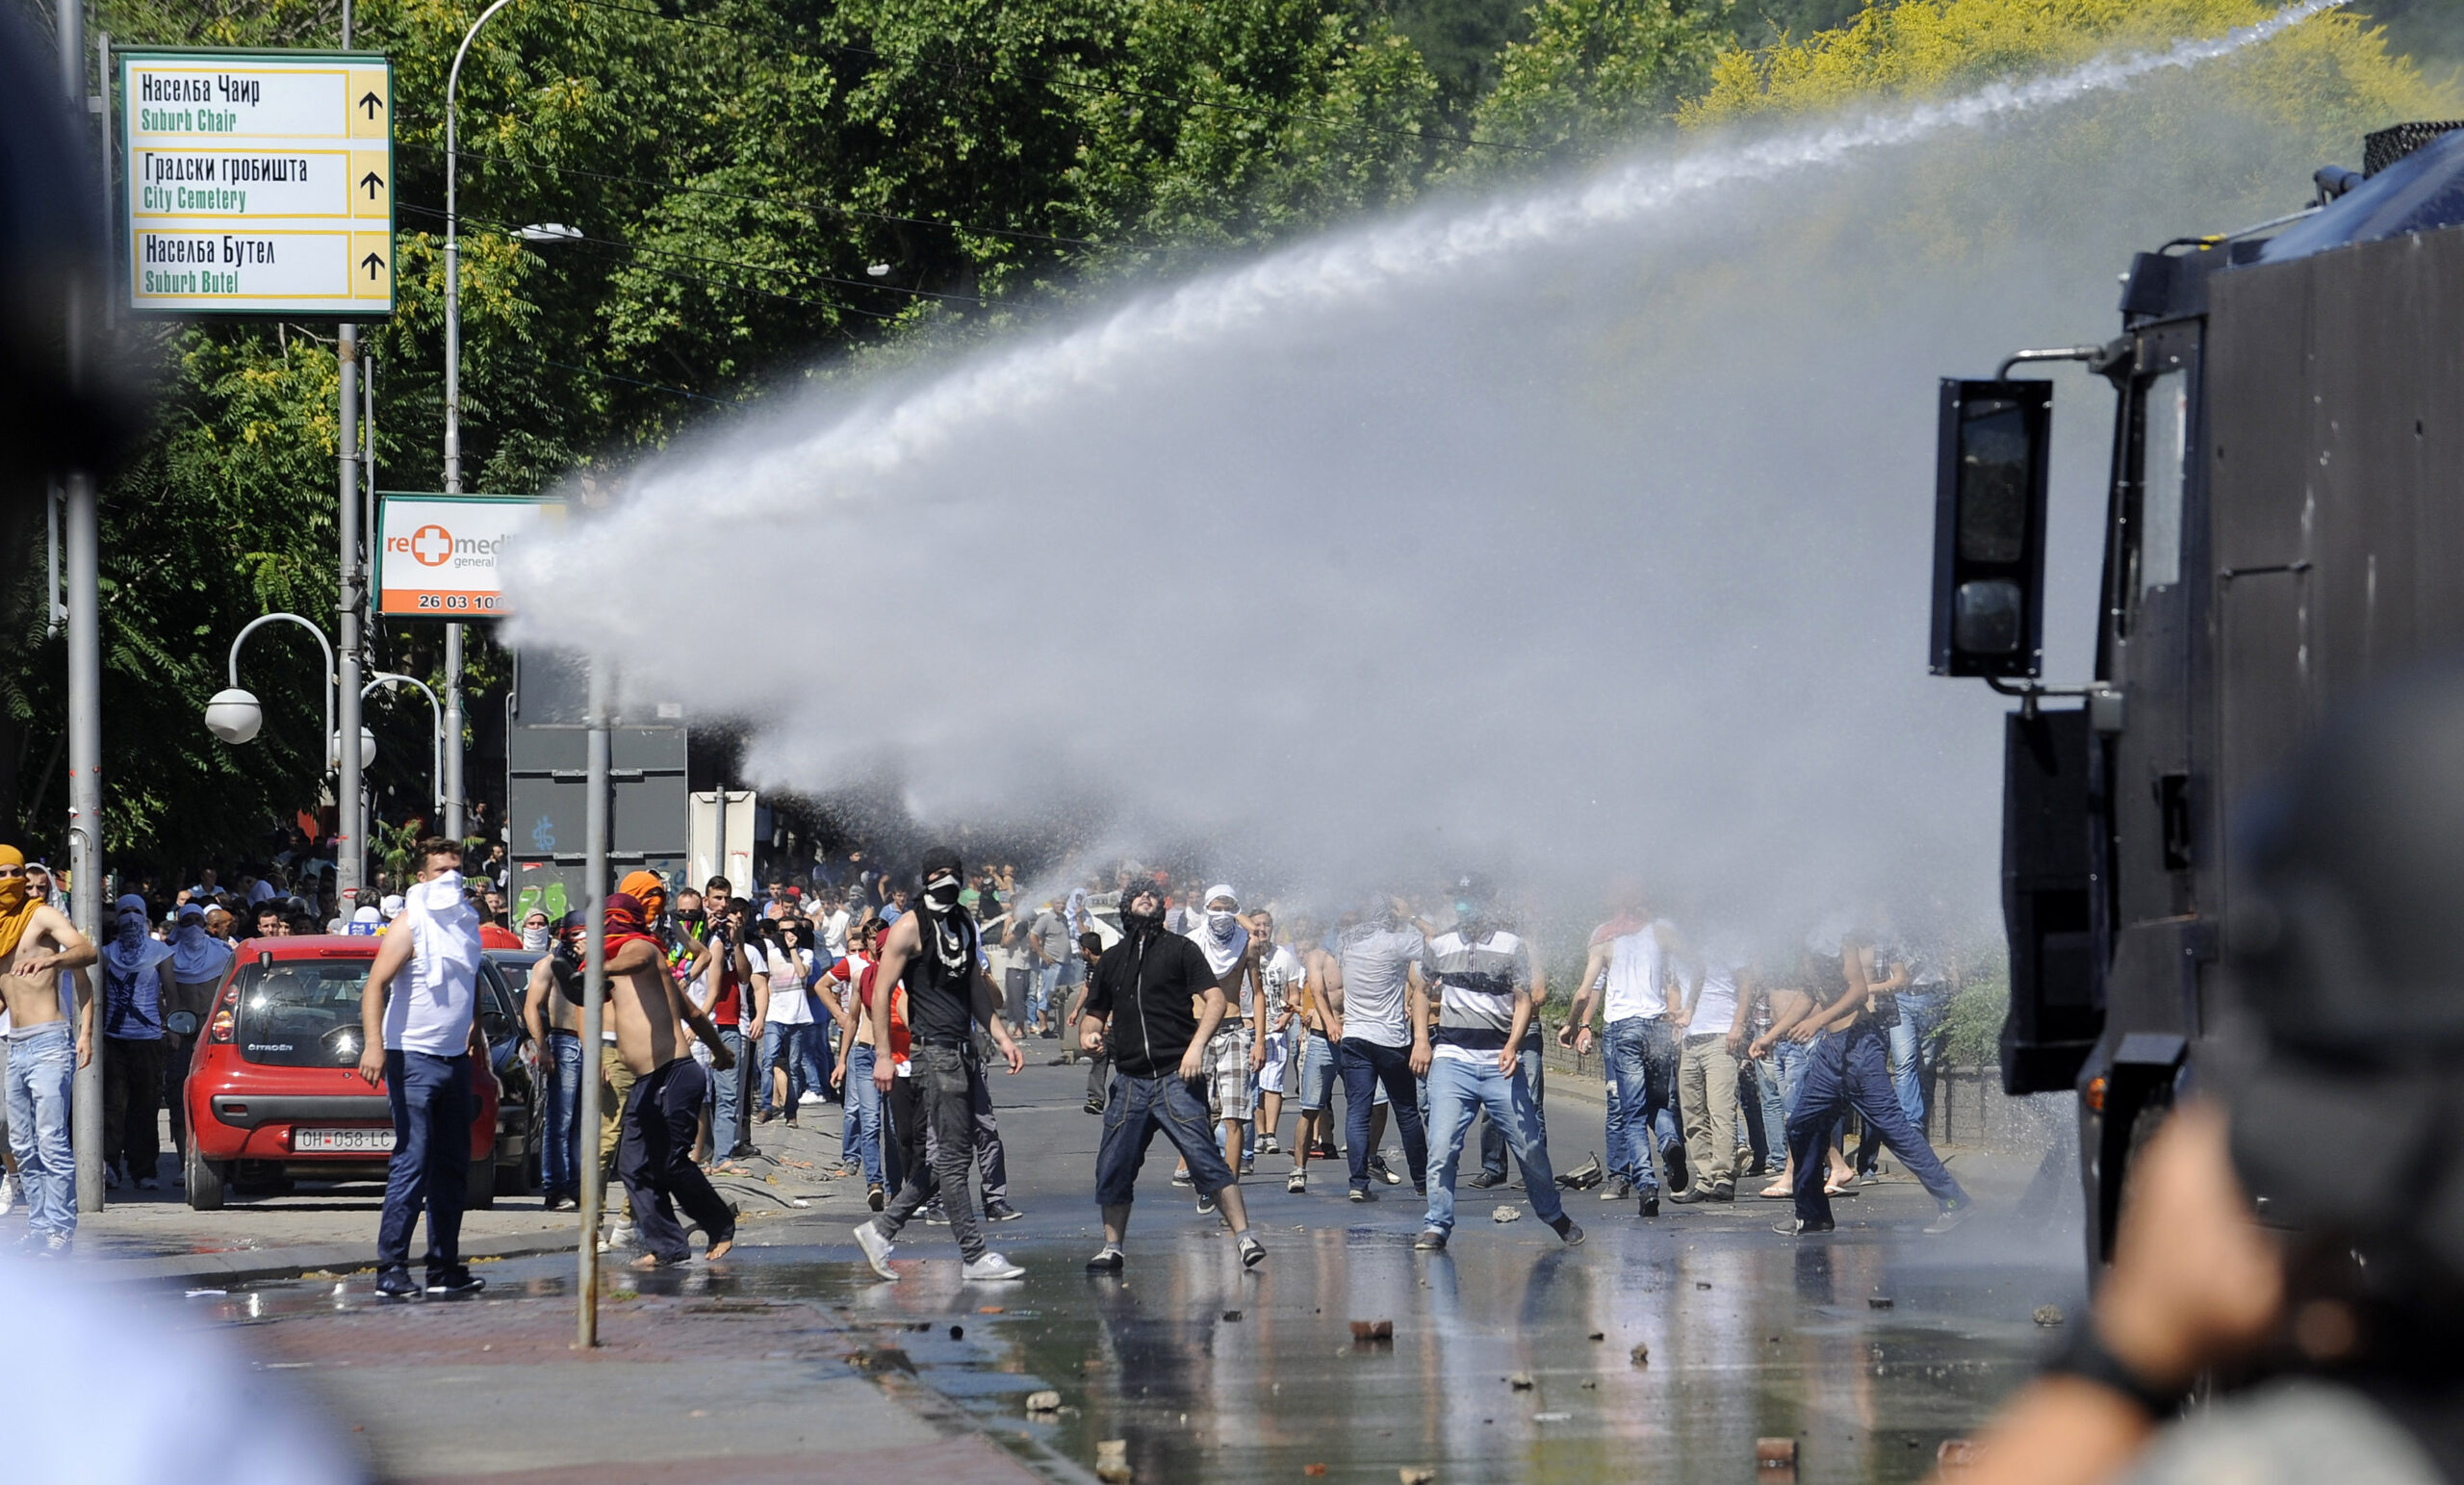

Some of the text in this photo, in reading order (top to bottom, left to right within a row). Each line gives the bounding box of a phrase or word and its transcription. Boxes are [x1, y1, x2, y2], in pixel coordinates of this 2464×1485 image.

[142, 74, 260, 107] Населба Чаир
[141, 108, 237, 133] Suburb Chair
[144, 152, 308, 185] Градски гробишта
[143, 186, 246, 214] City Cemetery
[145, 234, 275, 268] Населба Бутел
[145, 269, 239, 294] Suburb Butel
[454, 556, 494, 569] general
[419, 596, 440, 608] 26
[447, 596, 467, 608] 03
[302, 1131, 322, 1147] OH
